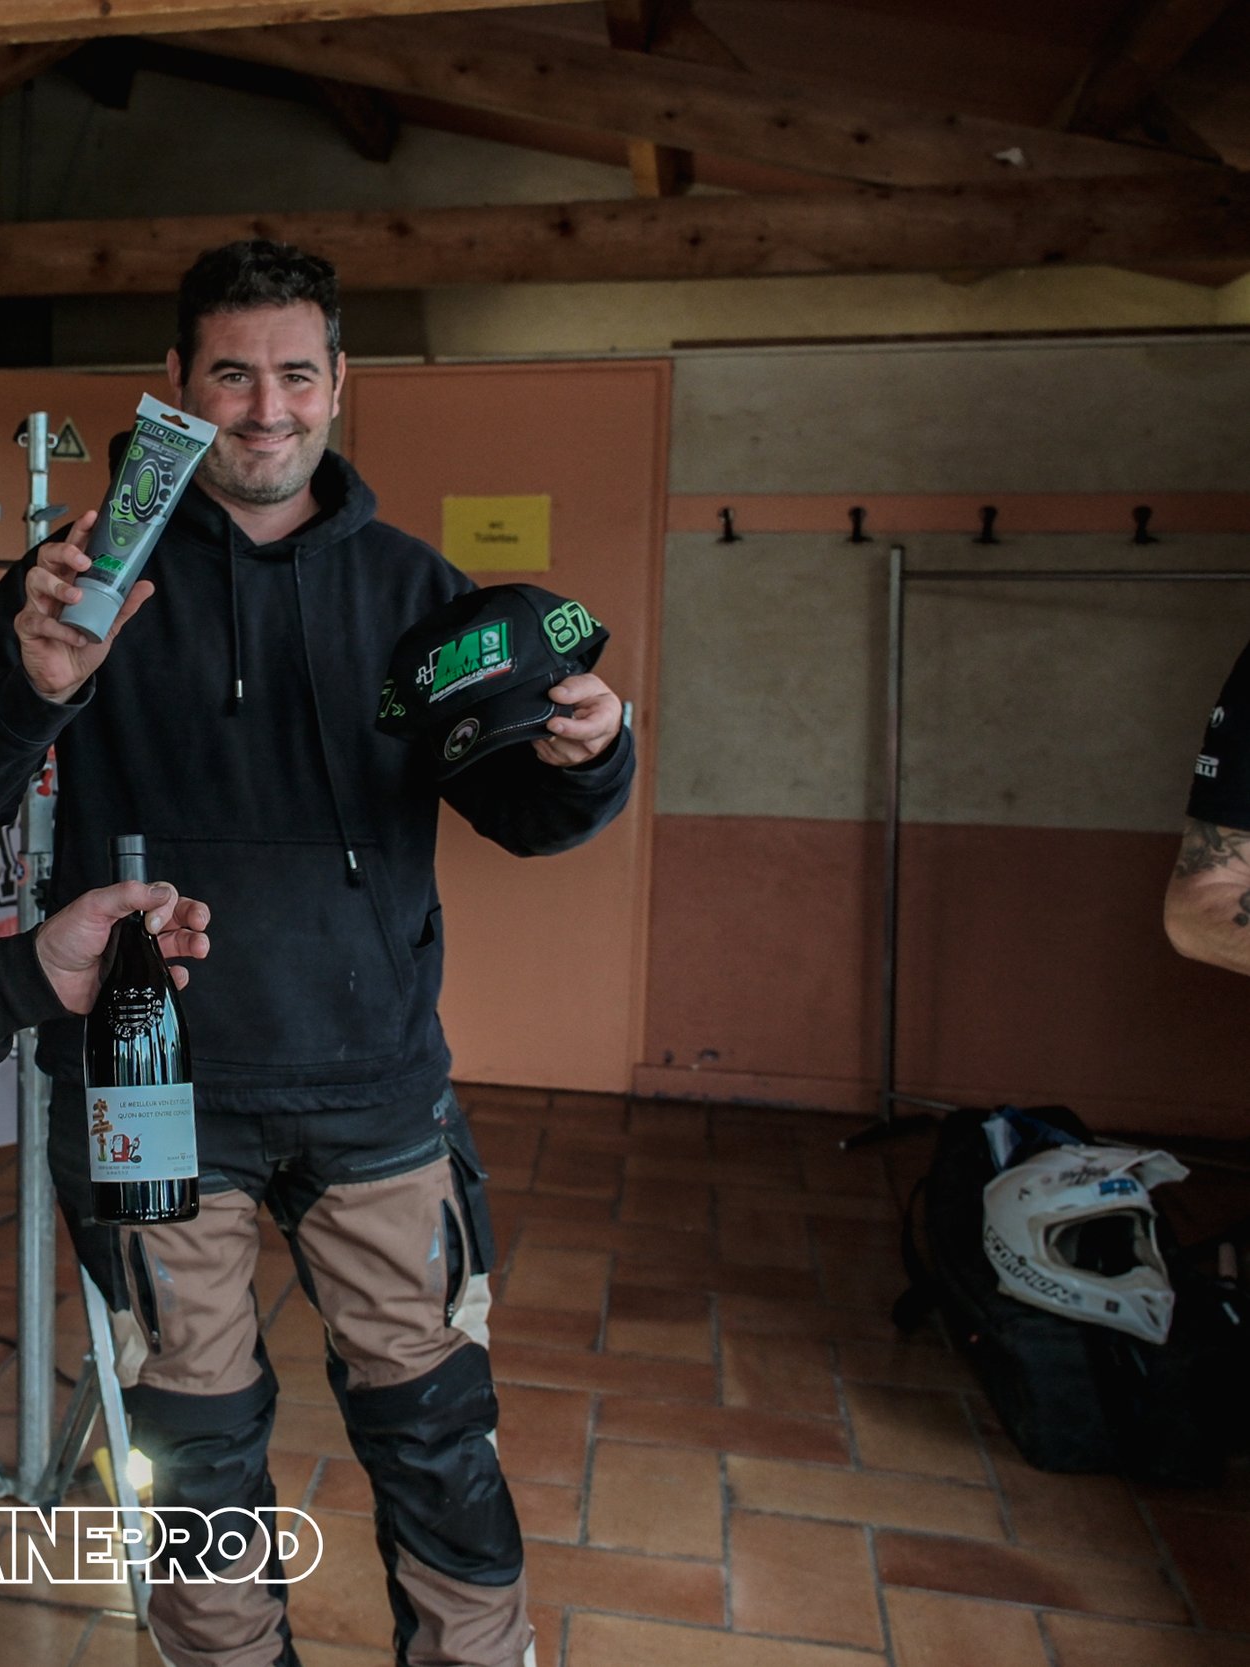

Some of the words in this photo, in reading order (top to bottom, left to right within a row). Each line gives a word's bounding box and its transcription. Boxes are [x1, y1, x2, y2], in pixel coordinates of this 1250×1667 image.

[543, 600, 594, 654] 87
[483, 655, 501, 666] OIL
[128, 1100, 157, 1108] MEILLEUR
[983, 1224, 1070, 1305] SCORPION
